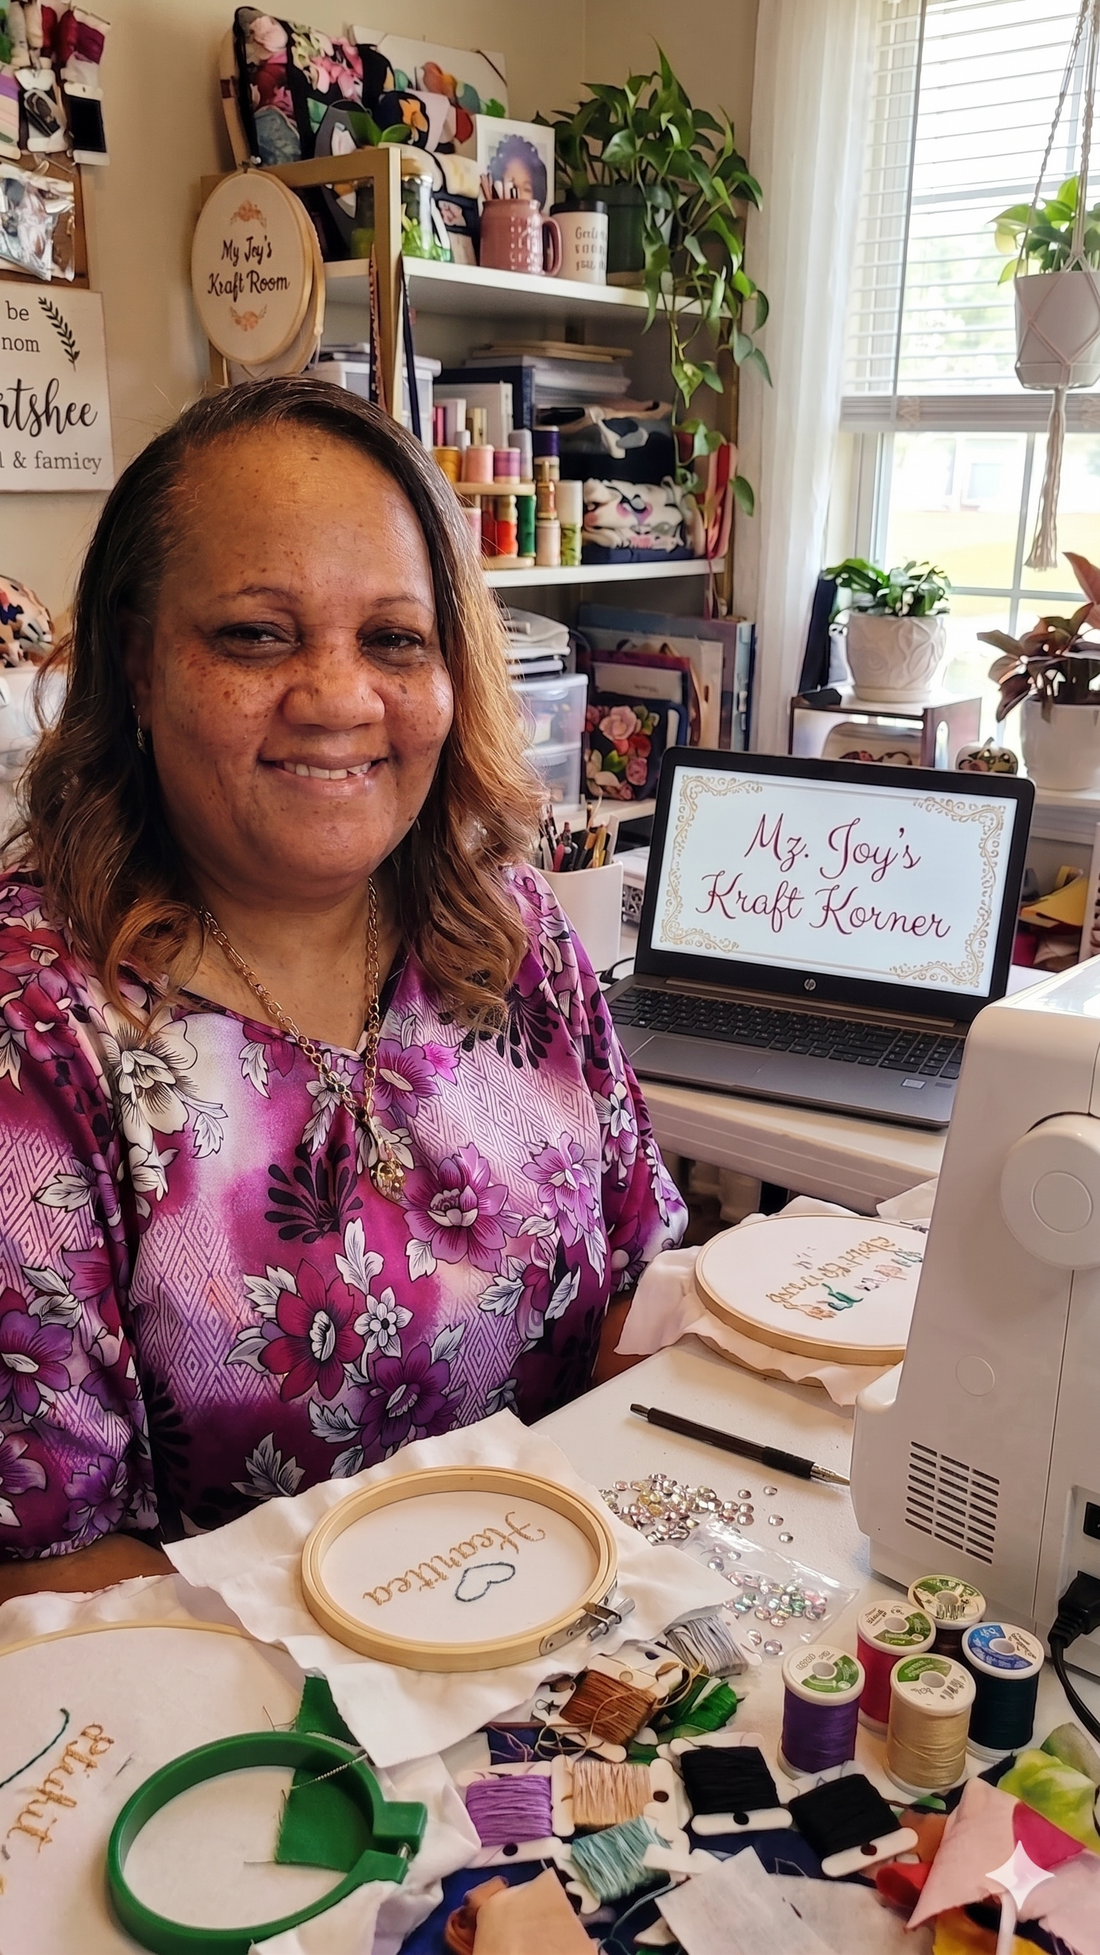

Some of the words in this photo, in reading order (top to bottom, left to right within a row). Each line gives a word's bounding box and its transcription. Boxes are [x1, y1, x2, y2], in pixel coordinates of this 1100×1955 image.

[221, 238, 240, 267] My
[244, 234, 273, 266] Joy's
[207, 271, 245, 303] Kraft
[246, 269, 291, 294] Room
[5, 300, 30, 322] be
[13, 450, 28, 470] &
[744, 812, 810, 873] Mz.
[818, 817, 922, 883] Joy's
[695, 869, 806, 934] Kraft
[808, 883, 952, 939] Korner
